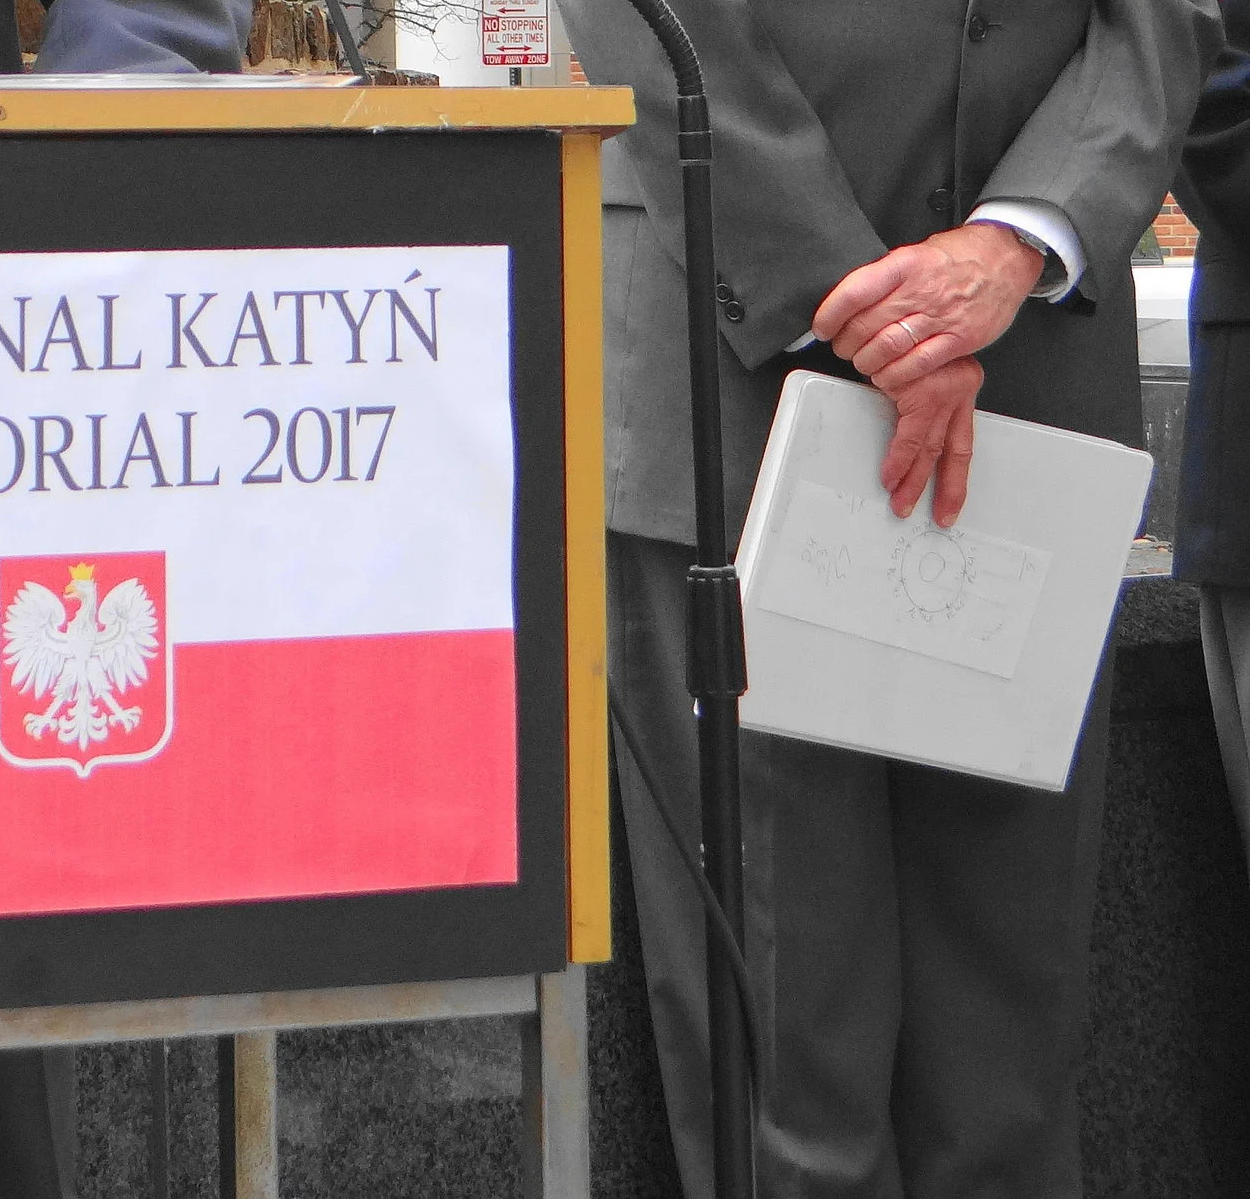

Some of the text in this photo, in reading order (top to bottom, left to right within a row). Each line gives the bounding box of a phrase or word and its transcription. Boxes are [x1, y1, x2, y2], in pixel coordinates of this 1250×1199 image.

[484, 19, 544, 31] NO STOPPING
[487, 33, 544, 43] ALL OTHER TIMES
[485, 55, 546, 64] TOW AWAY ZONE
[165, 269, 441, 368] KATYŃ
[241, 405, 396, 486] 2017
